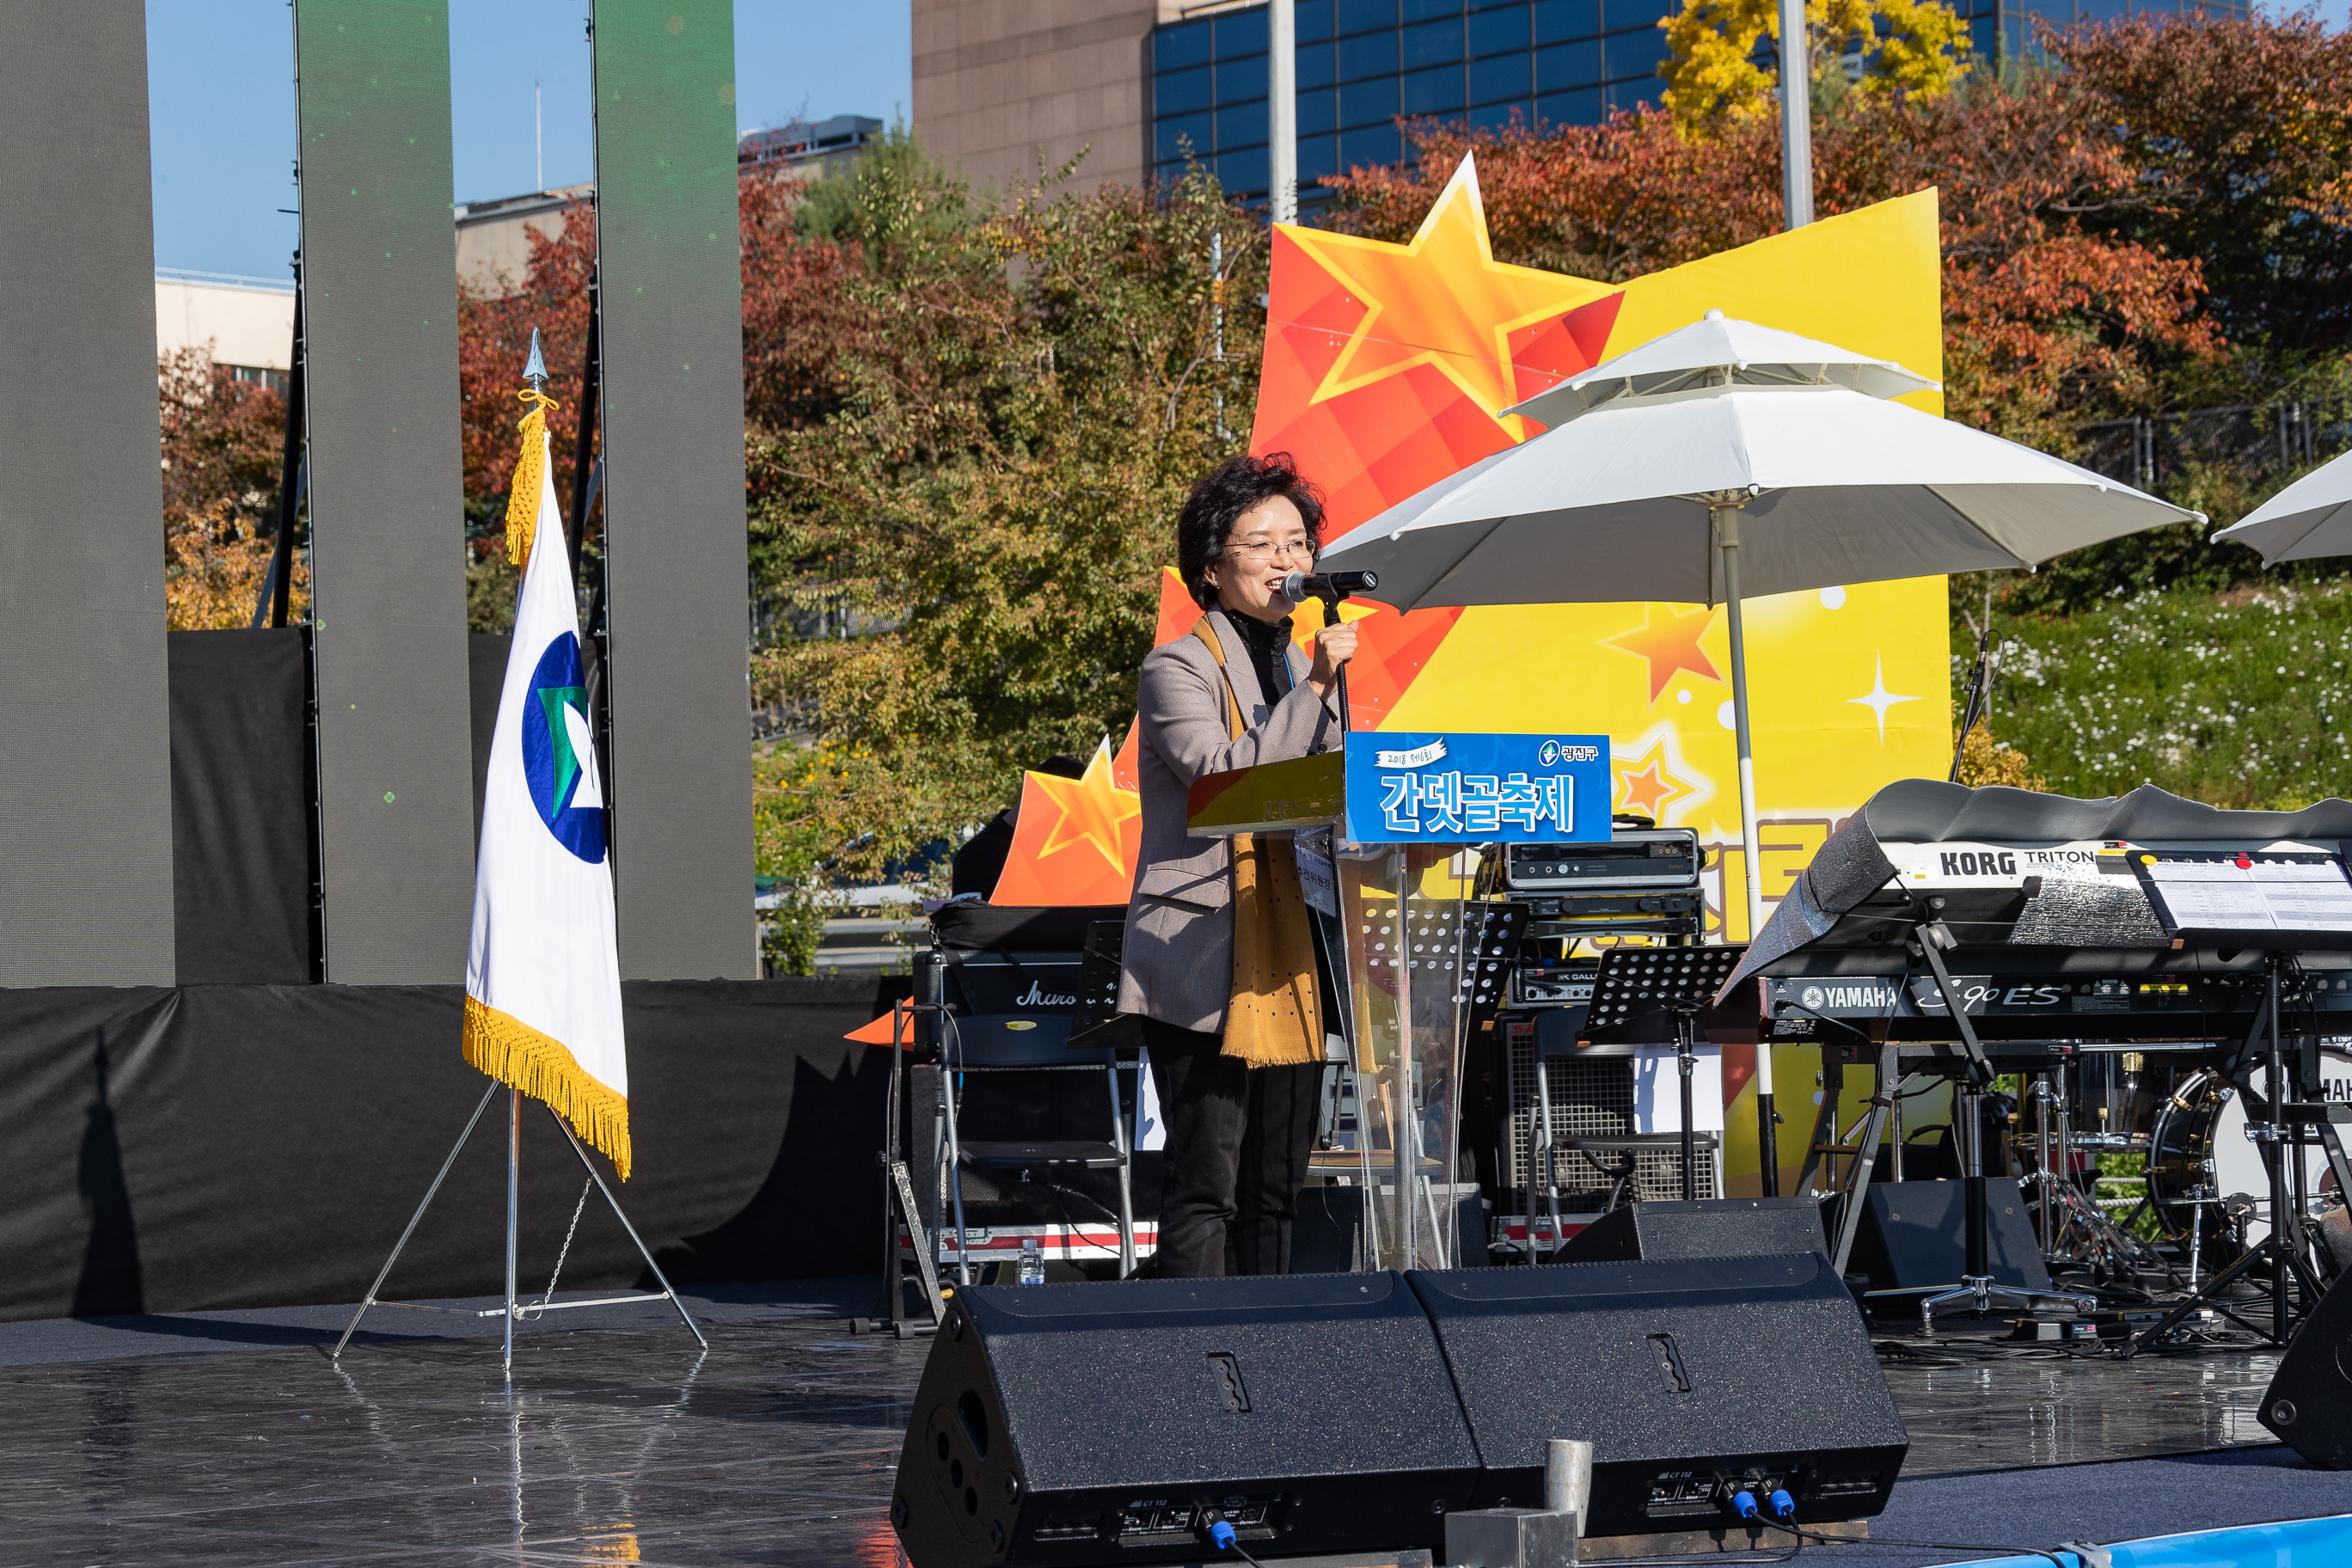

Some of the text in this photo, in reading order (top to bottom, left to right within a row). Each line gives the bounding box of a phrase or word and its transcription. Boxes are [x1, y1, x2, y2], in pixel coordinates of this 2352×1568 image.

[1388, 754, 1406, 765] 2018
[1561, 745, 1598, 762] 광진구
[1380, 771, 1574, 834] 간뎃골축제
[1939, 852, 2017, 876] KORG
[2024, 851, 2095, 863] TRITON
[1825, 987, 1897, 1008] YAMAHA
[2003, 987, 2062, 1005] ES
